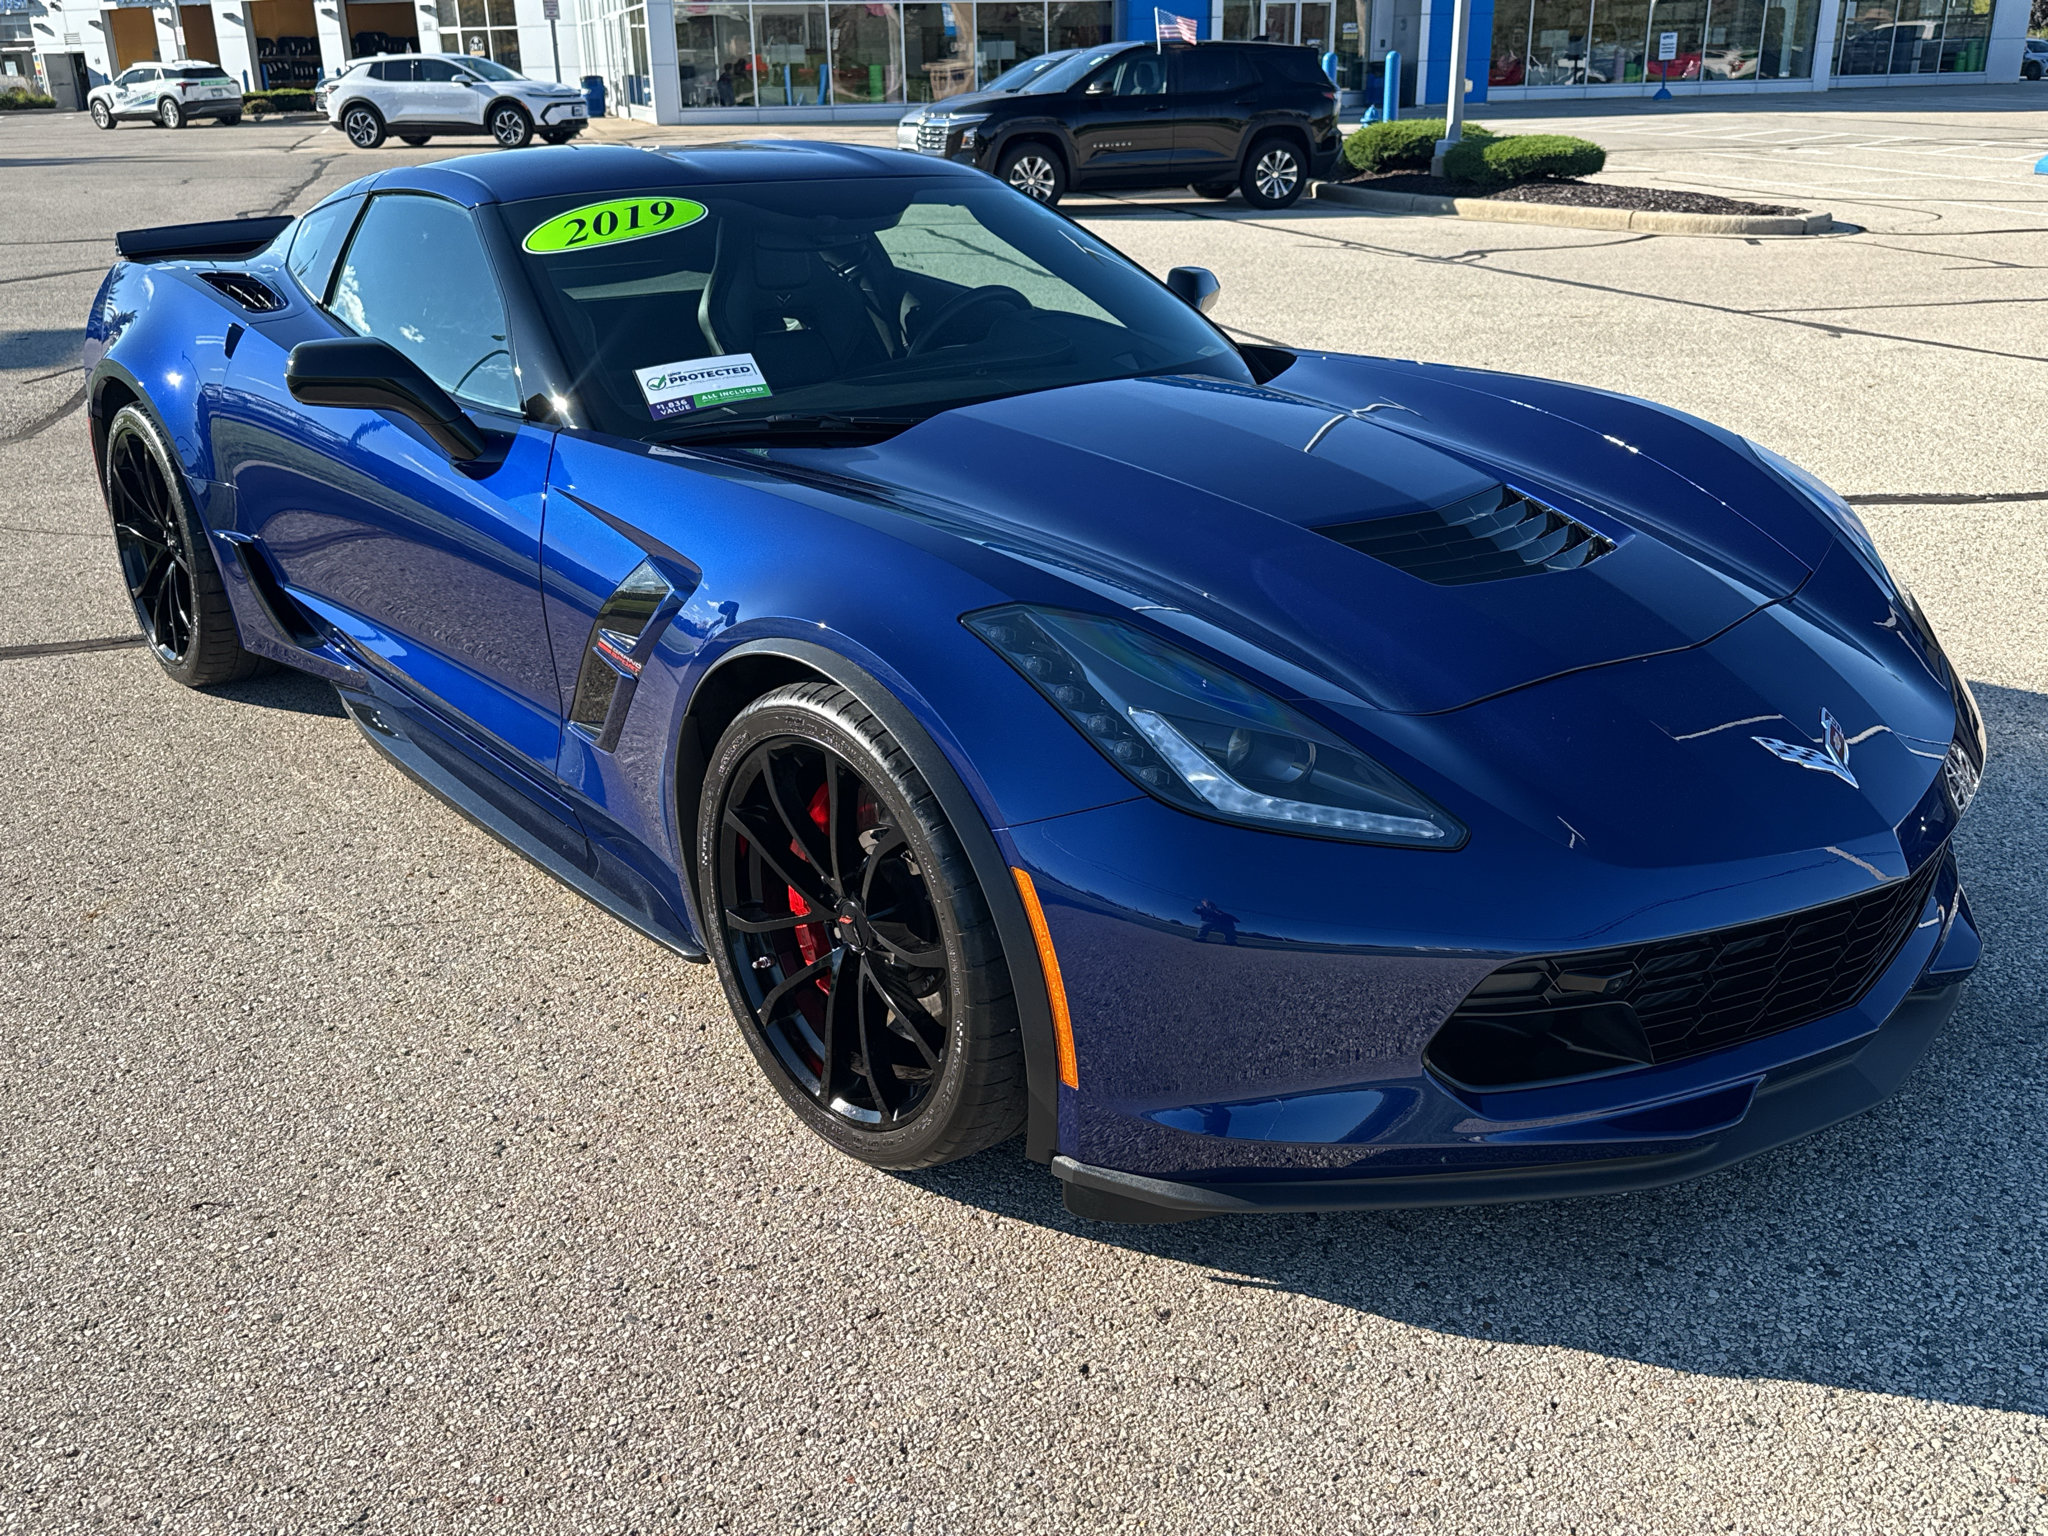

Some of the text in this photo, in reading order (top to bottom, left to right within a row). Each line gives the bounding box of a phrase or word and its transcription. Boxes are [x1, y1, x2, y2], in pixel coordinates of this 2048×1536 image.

[564, 201, 675, 246] 2019
[668, 366, 751, 385] PROTECTED
[701, 391, 718, 401] ALL
[719, 386, 765, 398] INCLUDED
[660, 403, 692, 416] VALUE
